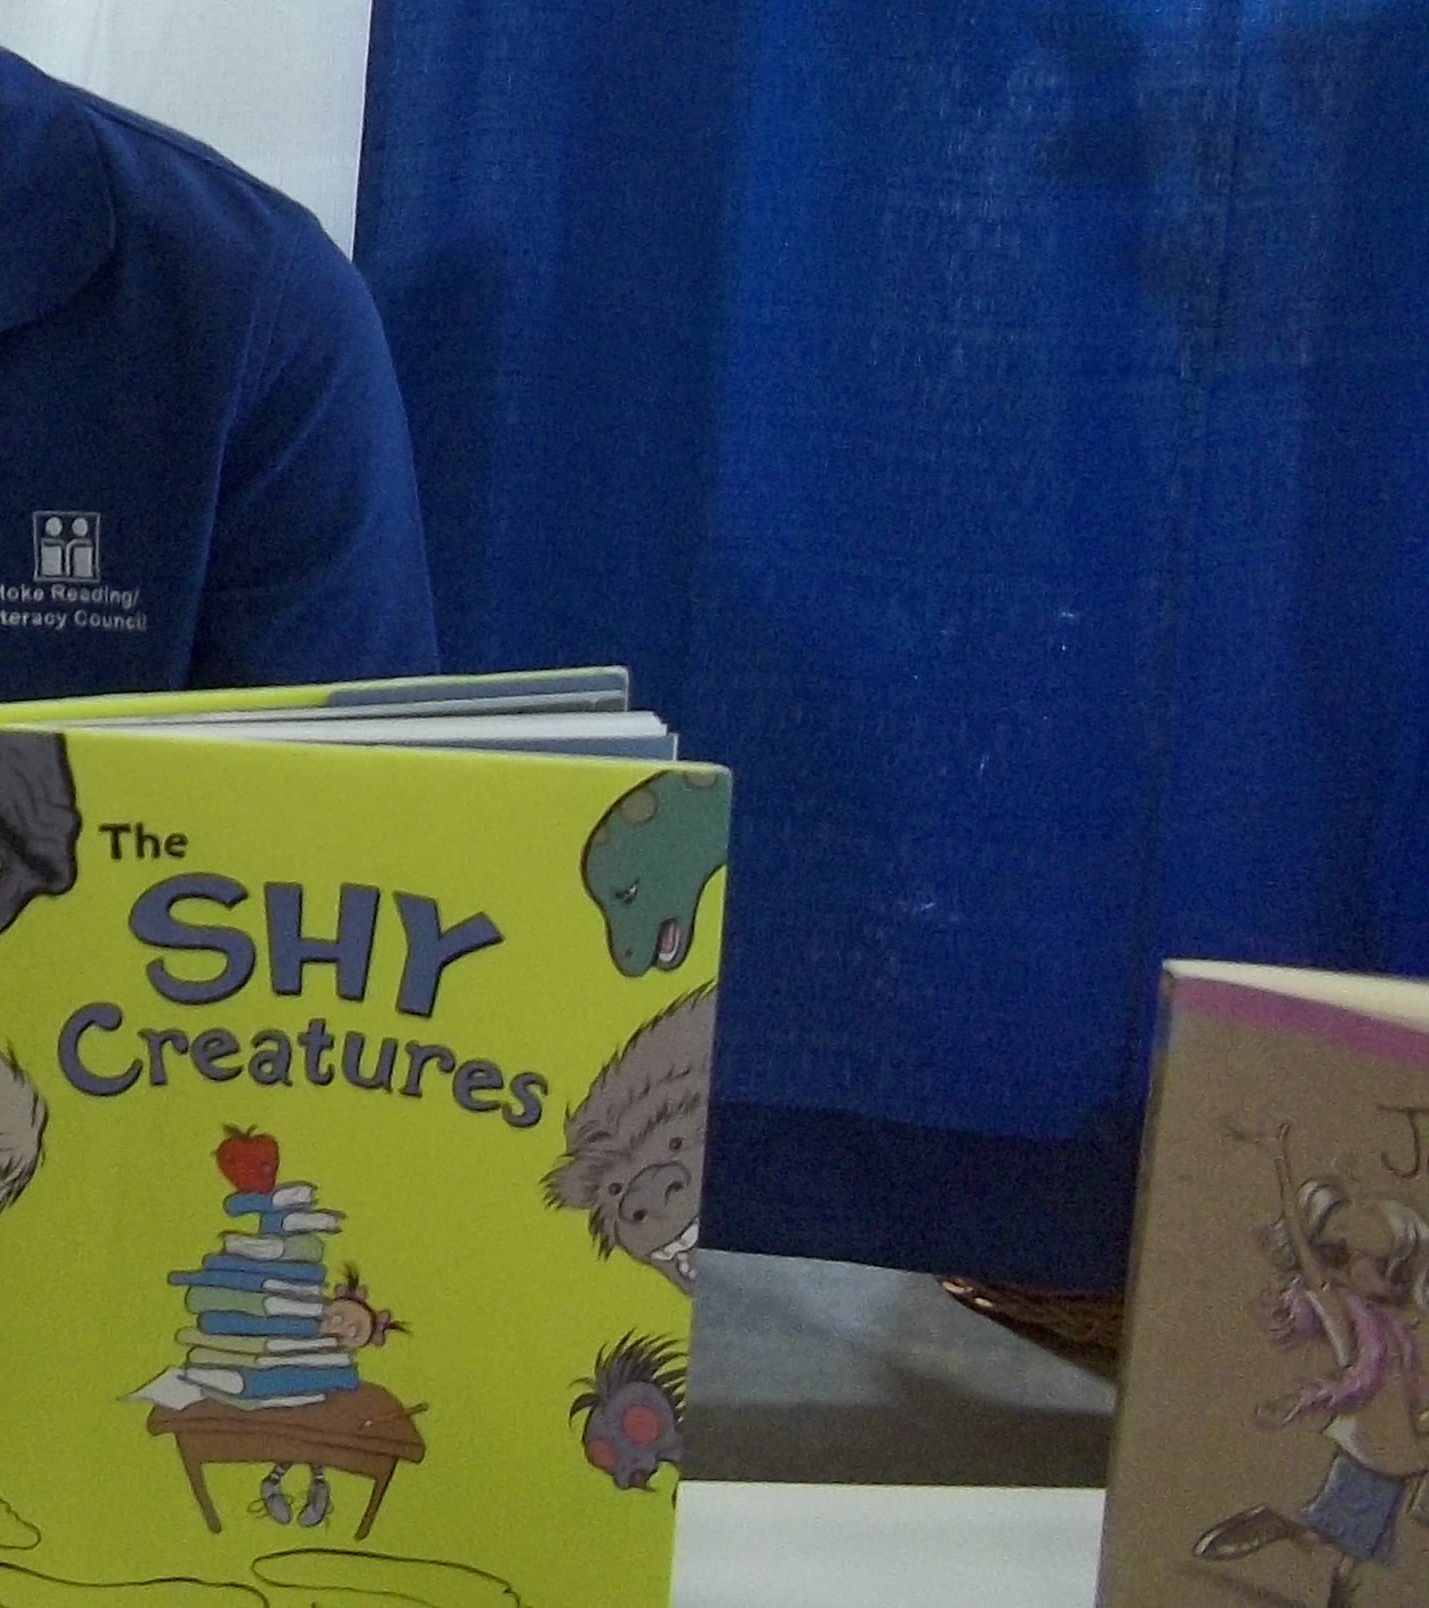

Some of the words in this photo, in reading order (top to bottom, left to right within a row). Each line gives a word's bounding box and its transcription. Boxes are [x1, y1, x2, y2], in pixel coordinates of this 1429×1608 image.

[74, 610, 146, 630] Council
[99, 823, 188, 860] The
[128, 872, 504, 1020] SHY
[57, 997, 548, 1129] Creatures
